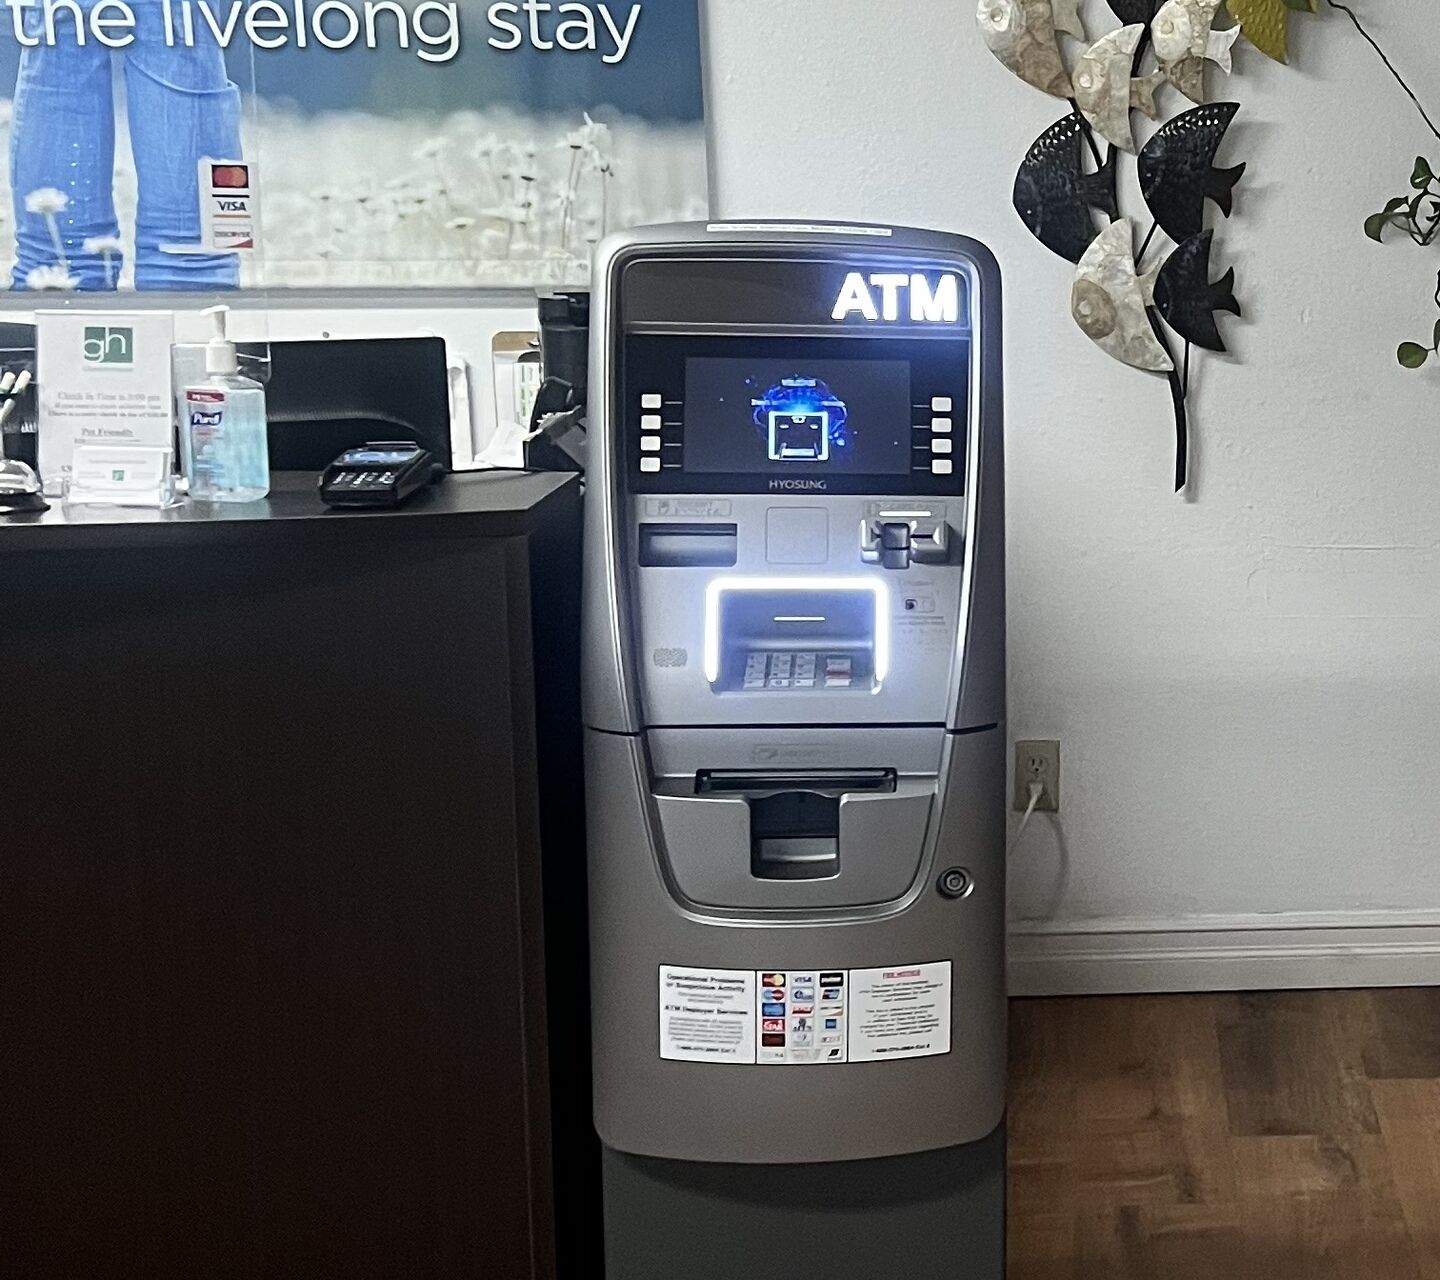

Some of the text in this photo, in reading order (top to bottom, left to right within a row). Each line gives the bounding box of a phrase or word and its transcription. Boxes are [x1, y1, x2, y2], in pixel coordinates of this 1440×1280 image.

[217, 200, 247, 212] VISA
[830, 271, 960, 323] ATM
[768, 479, 828, 491] HYOSUNG
